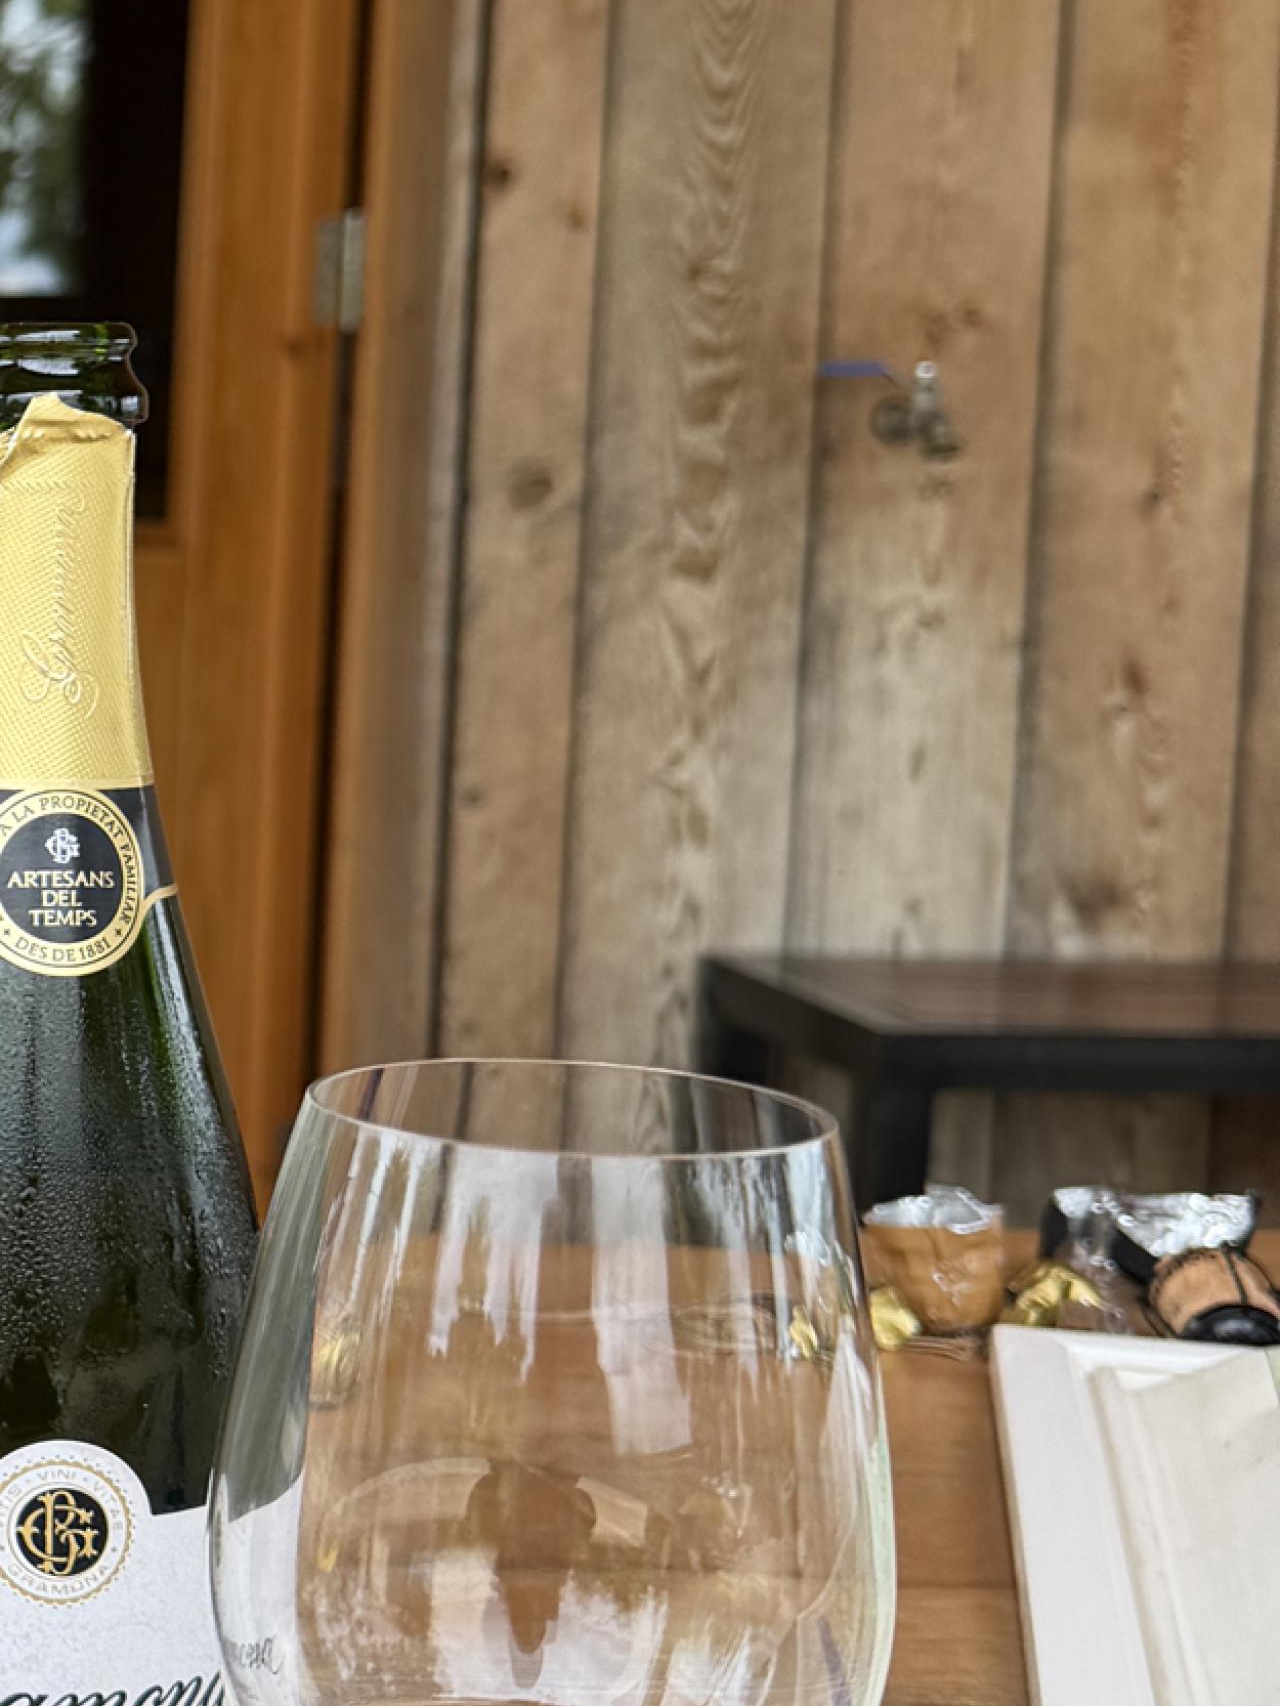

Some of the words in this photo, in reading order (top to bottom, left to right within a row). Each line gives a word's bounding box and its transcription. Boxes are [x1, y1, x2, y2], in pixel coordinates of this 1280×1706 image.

[0, 823, 13, 837] A
[12, 804, 35, 824] LA
[39, 795, 125, 838] PROPIETAT
[7, 870, 115, 889] ARTESANS
[41, 889, 83, 907] DEL
[28, 909, 97, 927] TEMPS
[52, 948, 77, 962] DE
